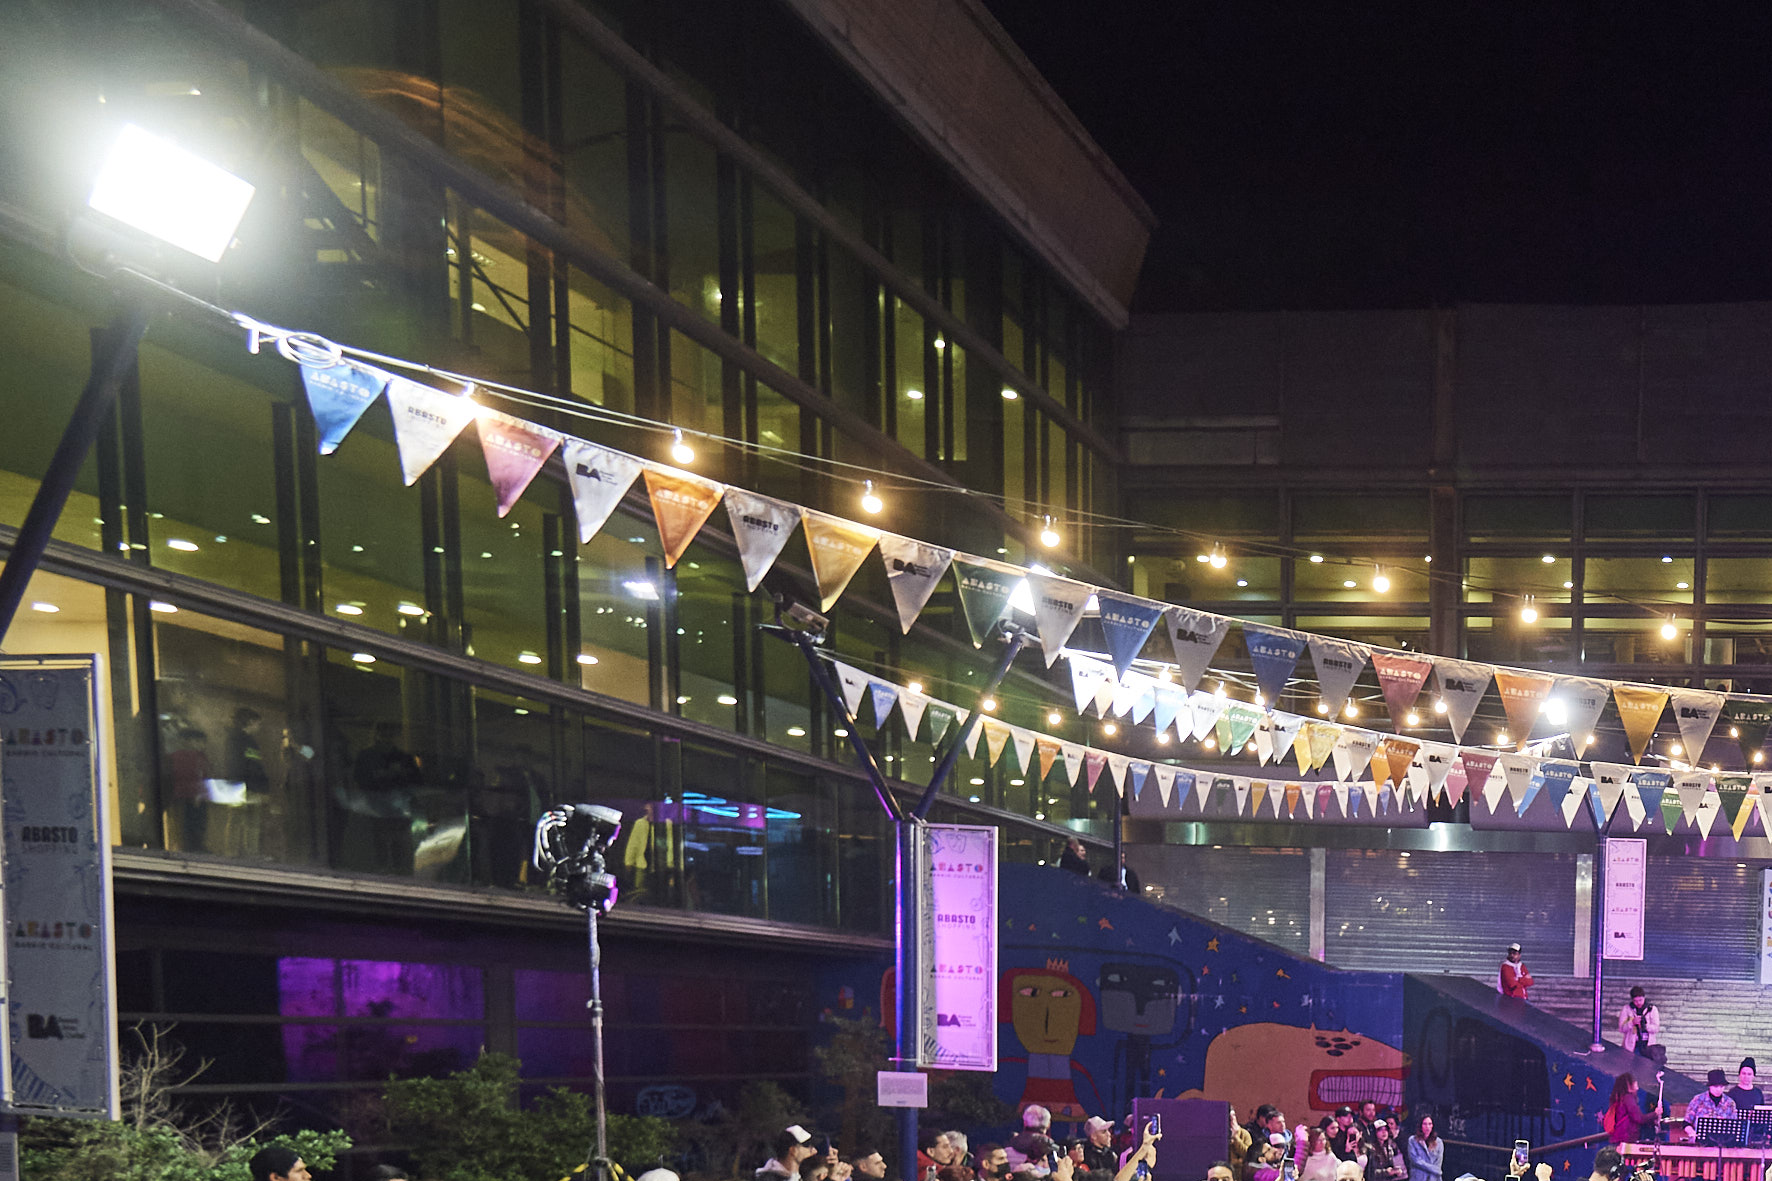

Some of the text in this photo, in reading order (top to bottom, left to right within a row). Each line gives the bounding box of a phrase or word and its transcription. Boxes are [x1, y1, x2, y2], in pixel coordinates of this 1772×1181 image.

[962, 577, 1010, 595] ABASTO
[1105, 613, 1150, 628] ABASTO
[1253, 645, 1296, 659] ABASTO
[1380, 668, 1422, 680] ABASTO
[1734, 713, 1771, 721] ABASTO
[1466, 761, 1493, 769] ABASTO
[1546, 770, 1572, 778] ABASTO
[1638, 779, 1665, 787] ABASTO
[1719, 784, 1746, 792] ABASTO
[22, 827, 78, 843] ABASTO
[930, 862, 983, 873] ABASTO
[938, 914, 976, 924] ABASTO
[16, 921, 92, 939] ABASTO
[931, 964, 983, 974] ABASTO
[937, 1014, 961, 1027] BA
[27, 1014, 63, 1040] BA
